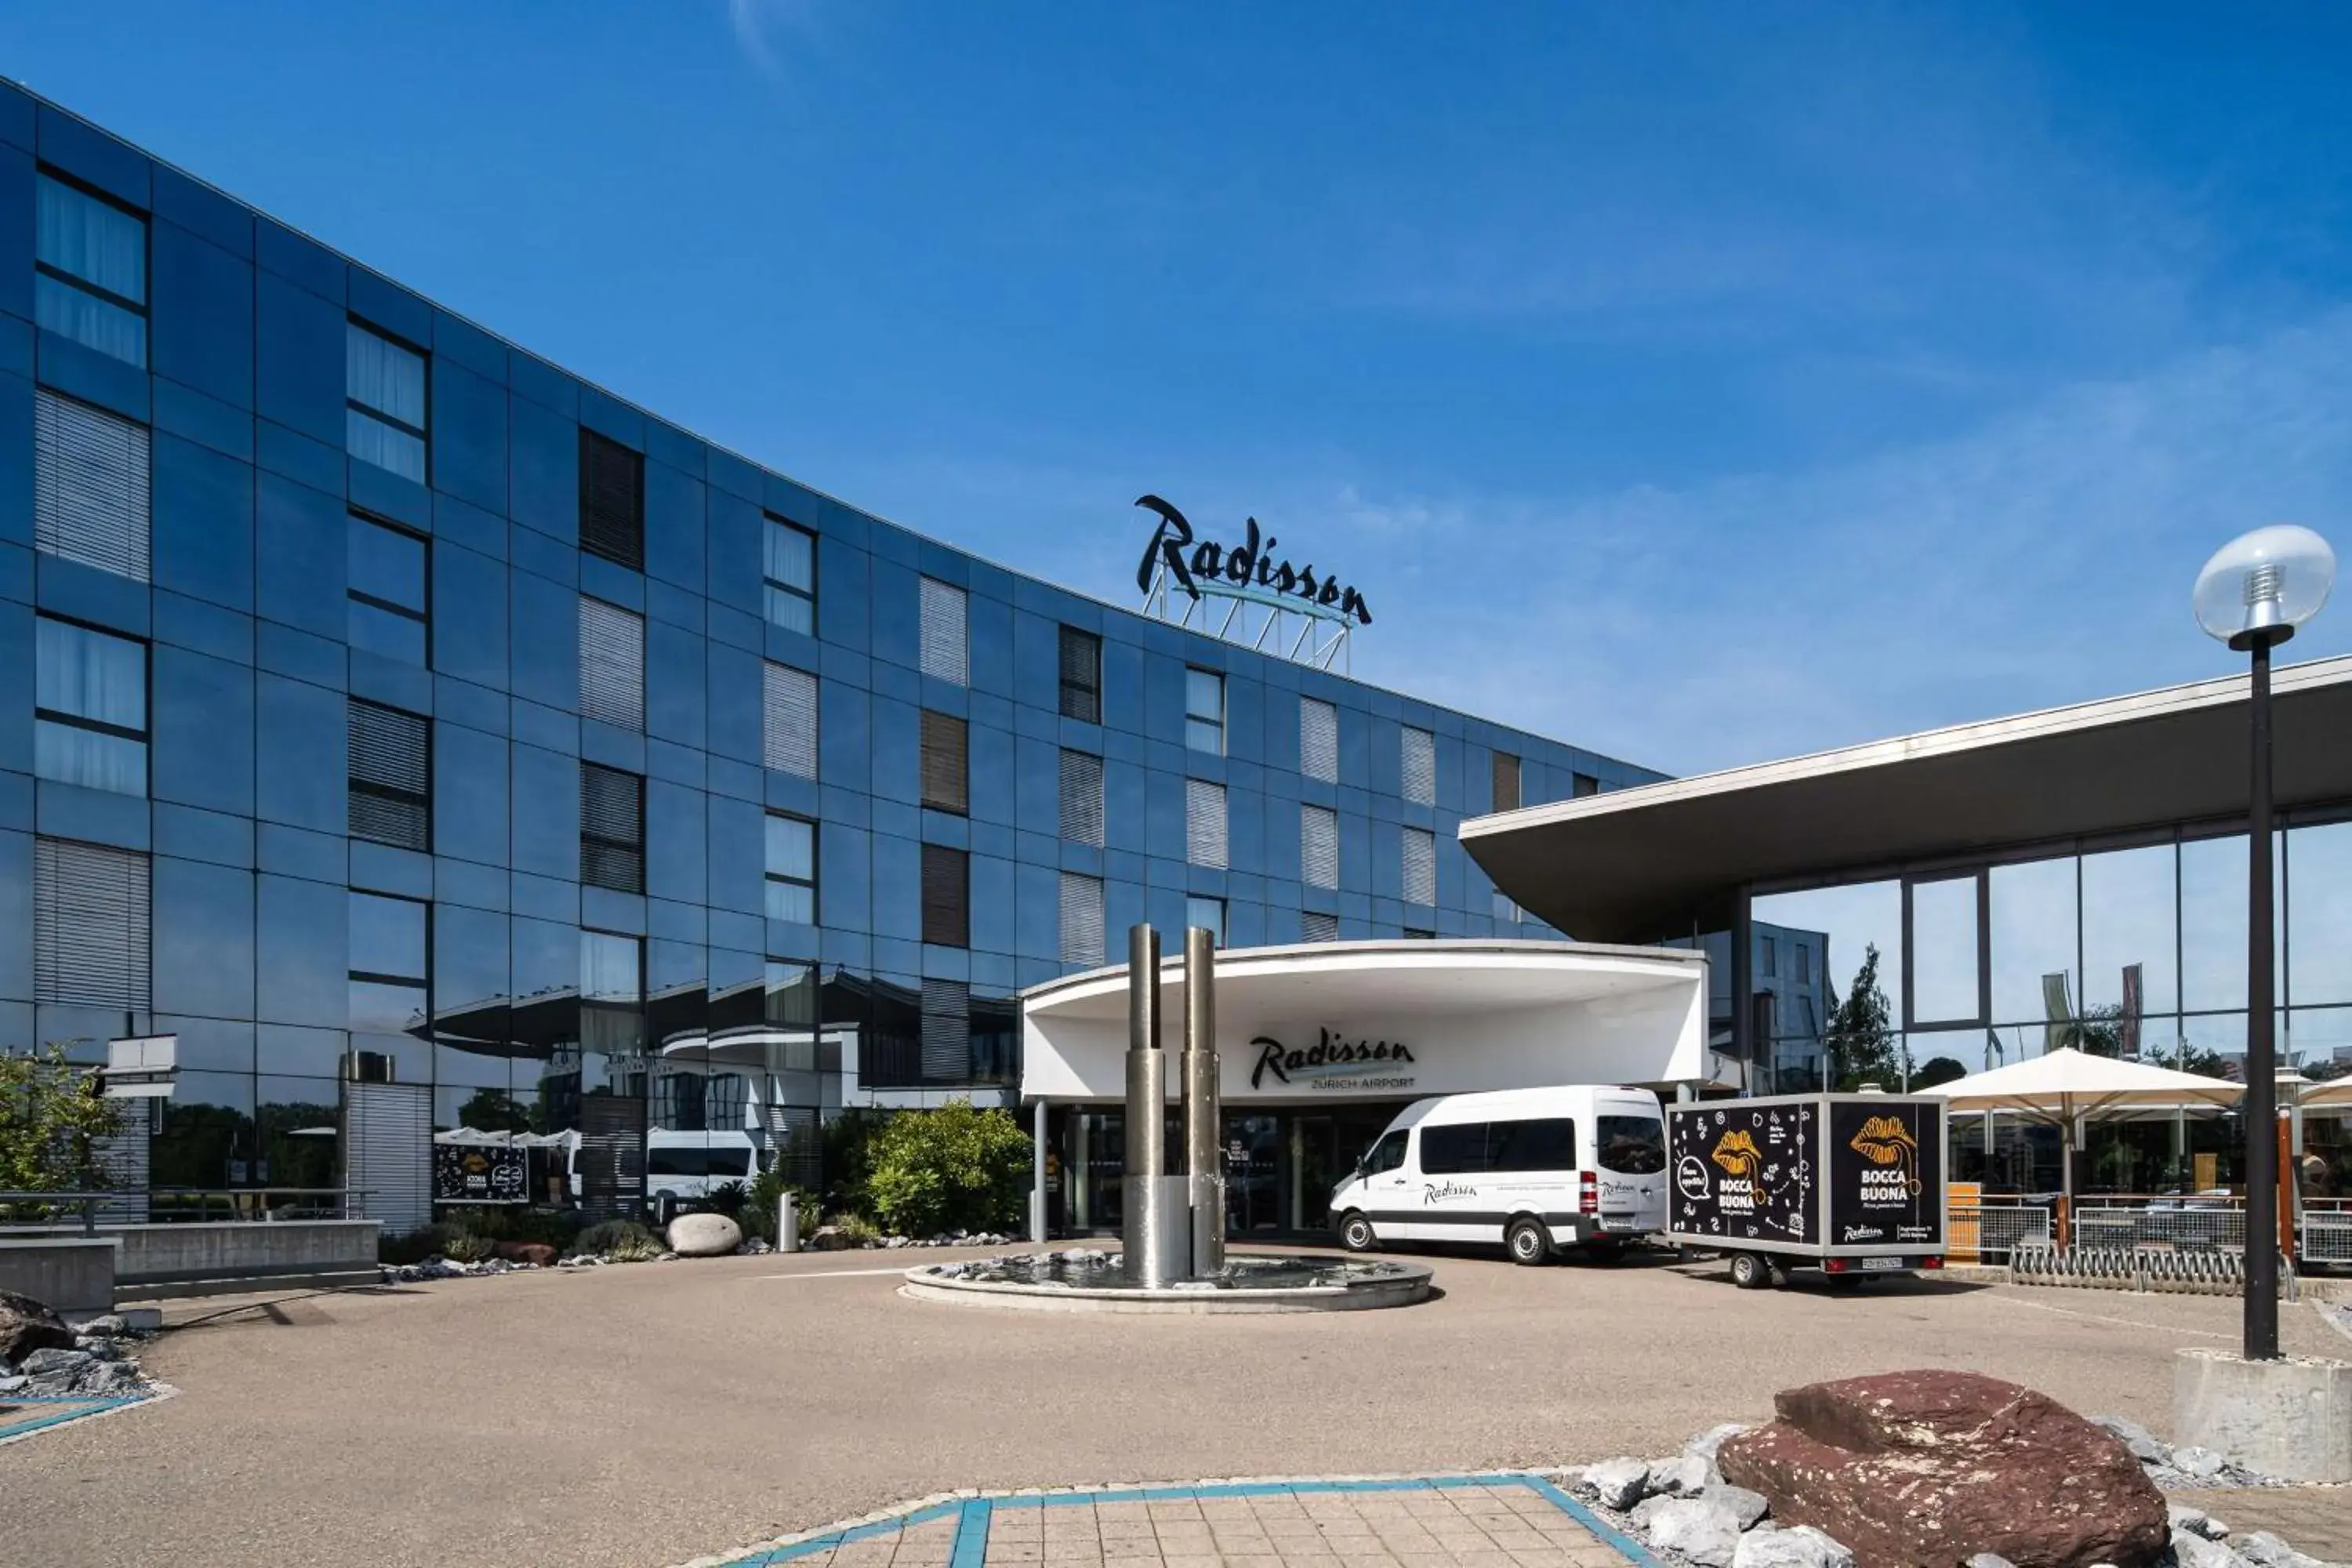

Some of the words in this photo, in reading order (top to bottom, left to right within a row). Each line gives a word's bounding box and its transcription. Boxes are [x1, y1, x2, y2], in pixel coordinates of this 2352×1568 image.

[1134, 495, 1372, 625] Radisson
[1250, 1026, 1415, 1090] Radisson
[1361, 1078, 1416, 1089] AIRPORT
[1861, 1170, 1906, 1184] BOCCA
[1719, 1178, 1754, 1192] BOCCA
[1424, 1180, 1478, 1206] Radisson
[1860, 1187, 1907, 1200] BUONA
[1719, 1195, 1755, 1208] BUONA
